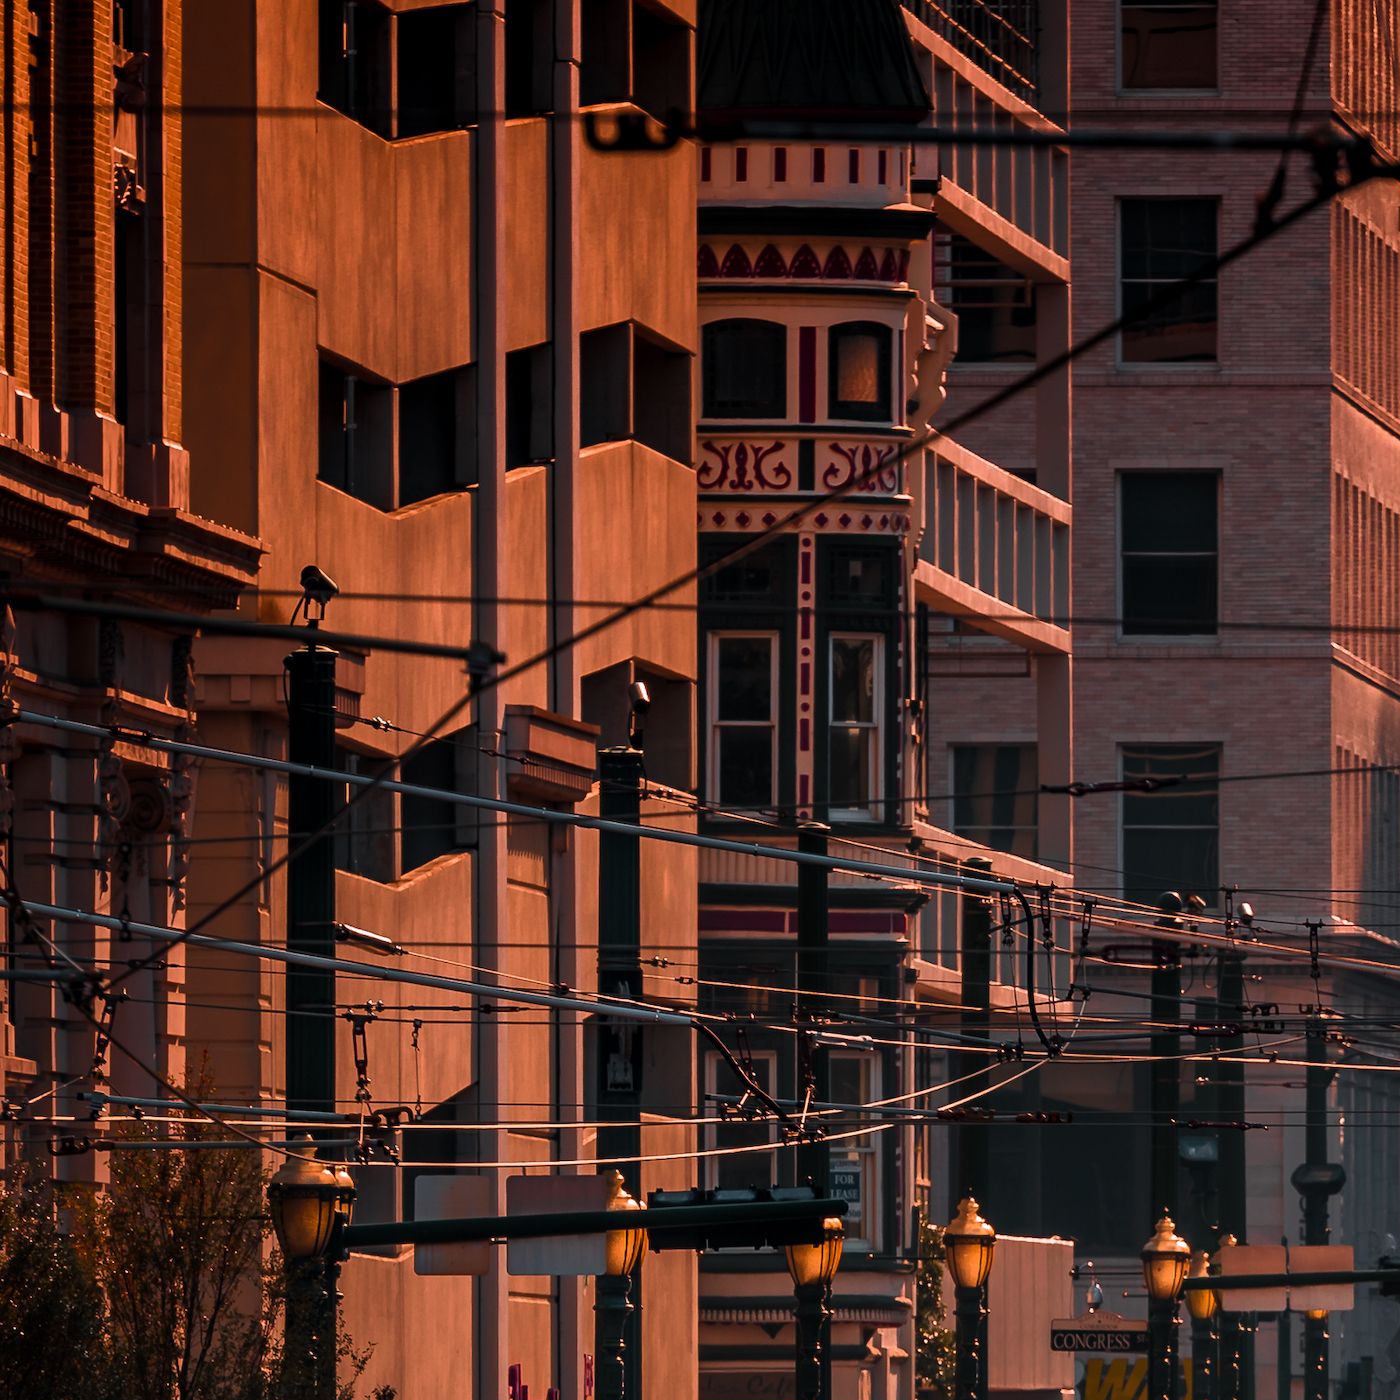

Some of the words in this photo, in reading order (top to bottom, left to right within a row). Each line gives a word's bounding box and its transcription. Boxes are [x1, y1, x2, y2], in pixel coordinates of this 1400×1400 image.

[834, 1174, 854, 1185] FOR
[830, 1190, 858, 1201] LEASE
[1053, 1332, 1130, 1350] CONGRESS
